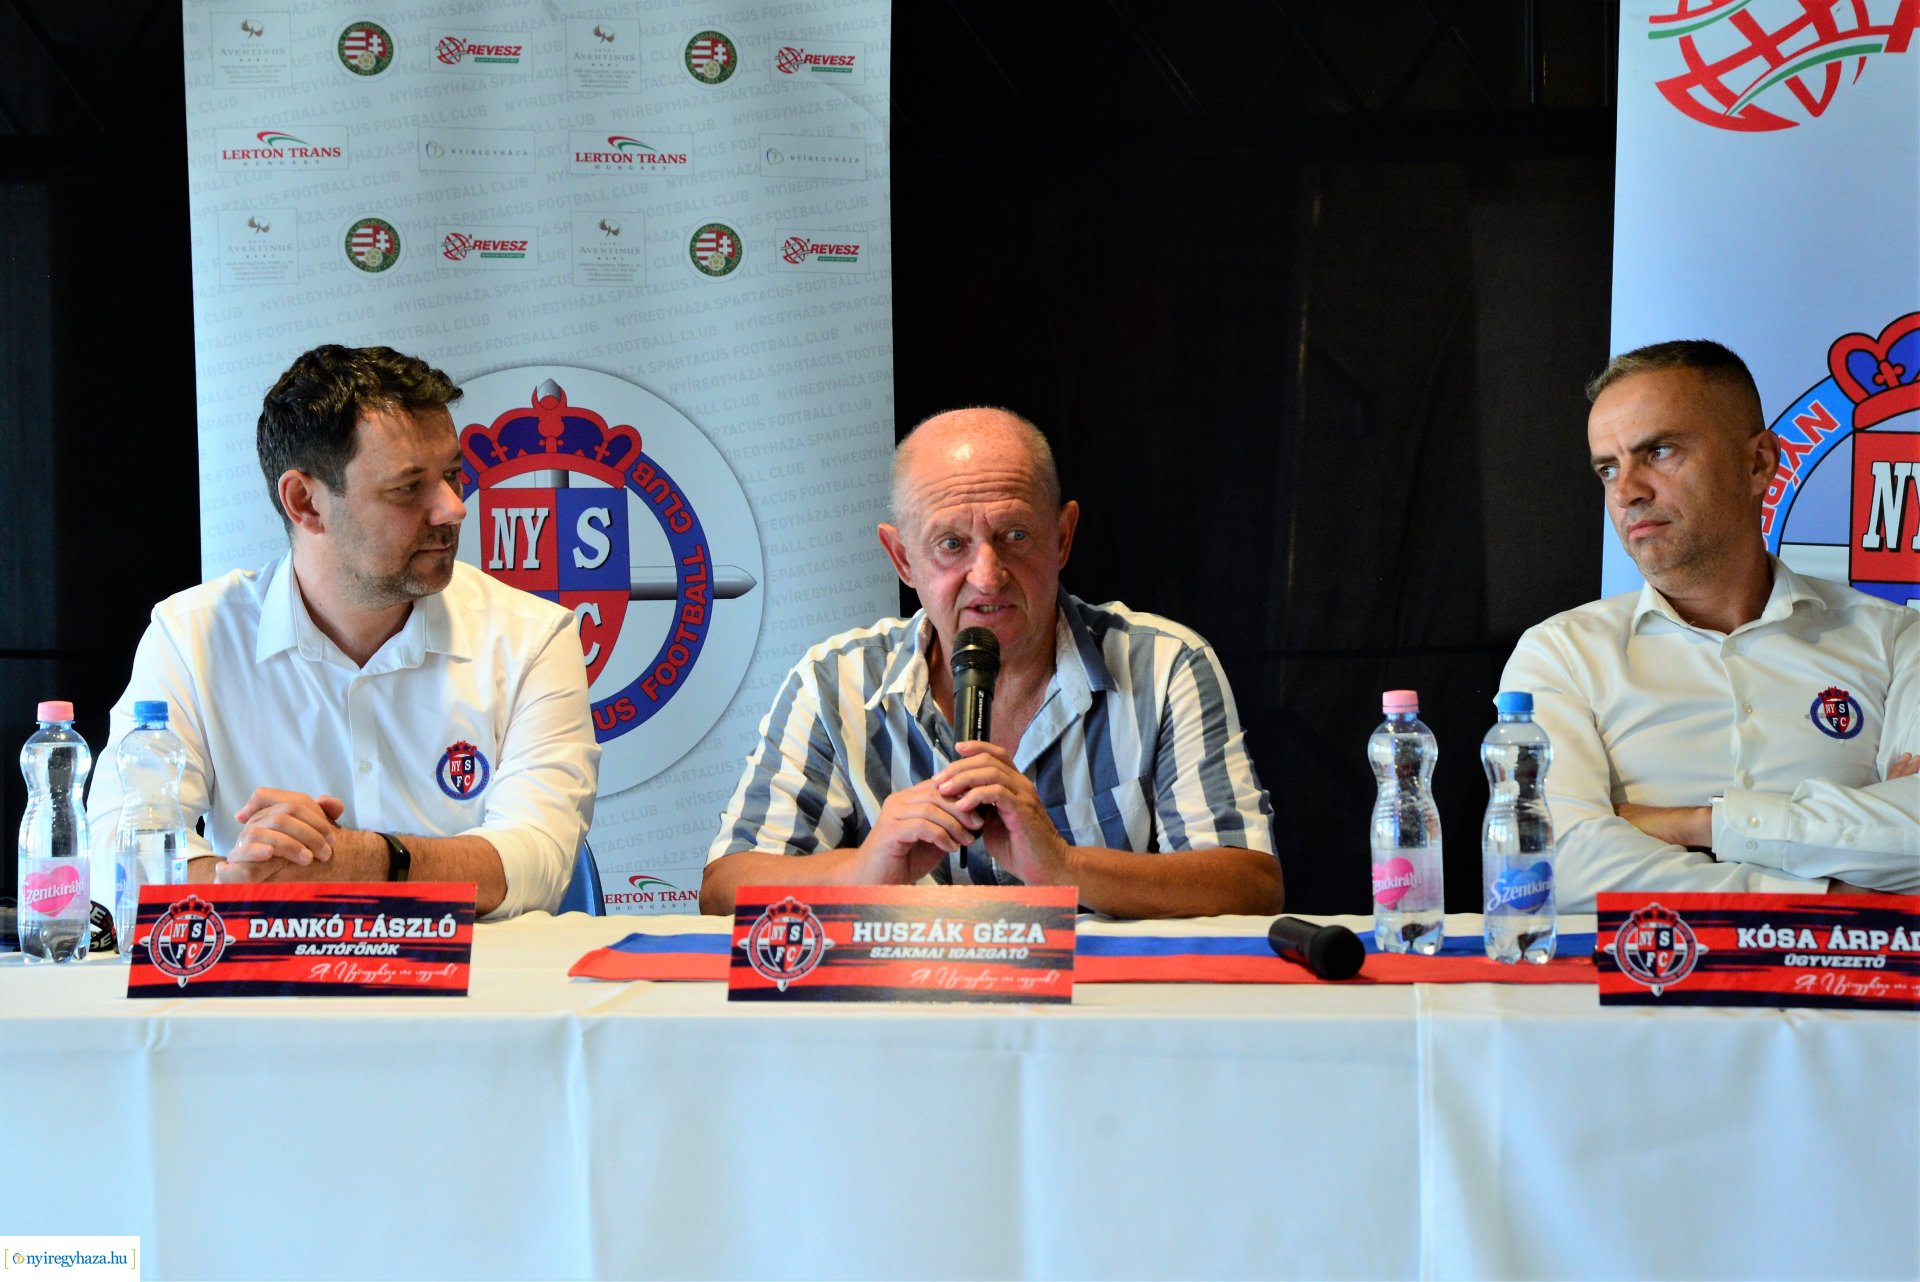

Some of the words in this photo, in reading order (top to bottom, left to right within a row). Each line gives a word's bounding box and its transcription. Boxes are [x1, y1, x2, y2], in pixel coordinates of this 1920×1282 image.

[466, 44, 523, 57] REVESZ
[803, 53, 856, 67] REVESZ
[222, 148, 284, 160] LERTON
[288, 147, 342, 158] TRANS
[575, 151, 633, 163] LERTON
[637, 152, 687, 164] TRANS
[471, 239, 529, 252] REVESZ
[809, 244, 860, 256] REVESZ
[630, 460, 693, 534] CLUB
[489, 507, 550, 570] NY
[572, 507, 612, 570] S
[640, 544, 708, 701] FOOTBALL
[1838, 703, 1845, 713] S
[1840, 717, 1847, 727] C
[464, 760, 471, 771] S
[464, 775, 470, 786] C
[604, 892, 654, 904] ERTON
[657, 890, 699, 902] TRAN
[615, 903, 687, 911] HUNGARY
[191, 922, 202, 938] S
[248, 913, 344, 939] DANKÓ
[353, 913, 457, 939] LÁSZLÓ
[789, 925, 801, 941] S
[852, 918, 964, 943] HUSZÁK
[973, 918, 1046, 943] GÉZA
[1659, 931, 1670, 946] S
[1737, 923, 1819, 949] KÓSA
[294, 941, 400, 956] SAJTÓFŐNÖK
[870, 946, 944, 959] SZAKMAI
[949, 946, 1030, 960] IGAZGATÓ
[1784, 953, 1887, 968] ÜGYVEZETŐ
